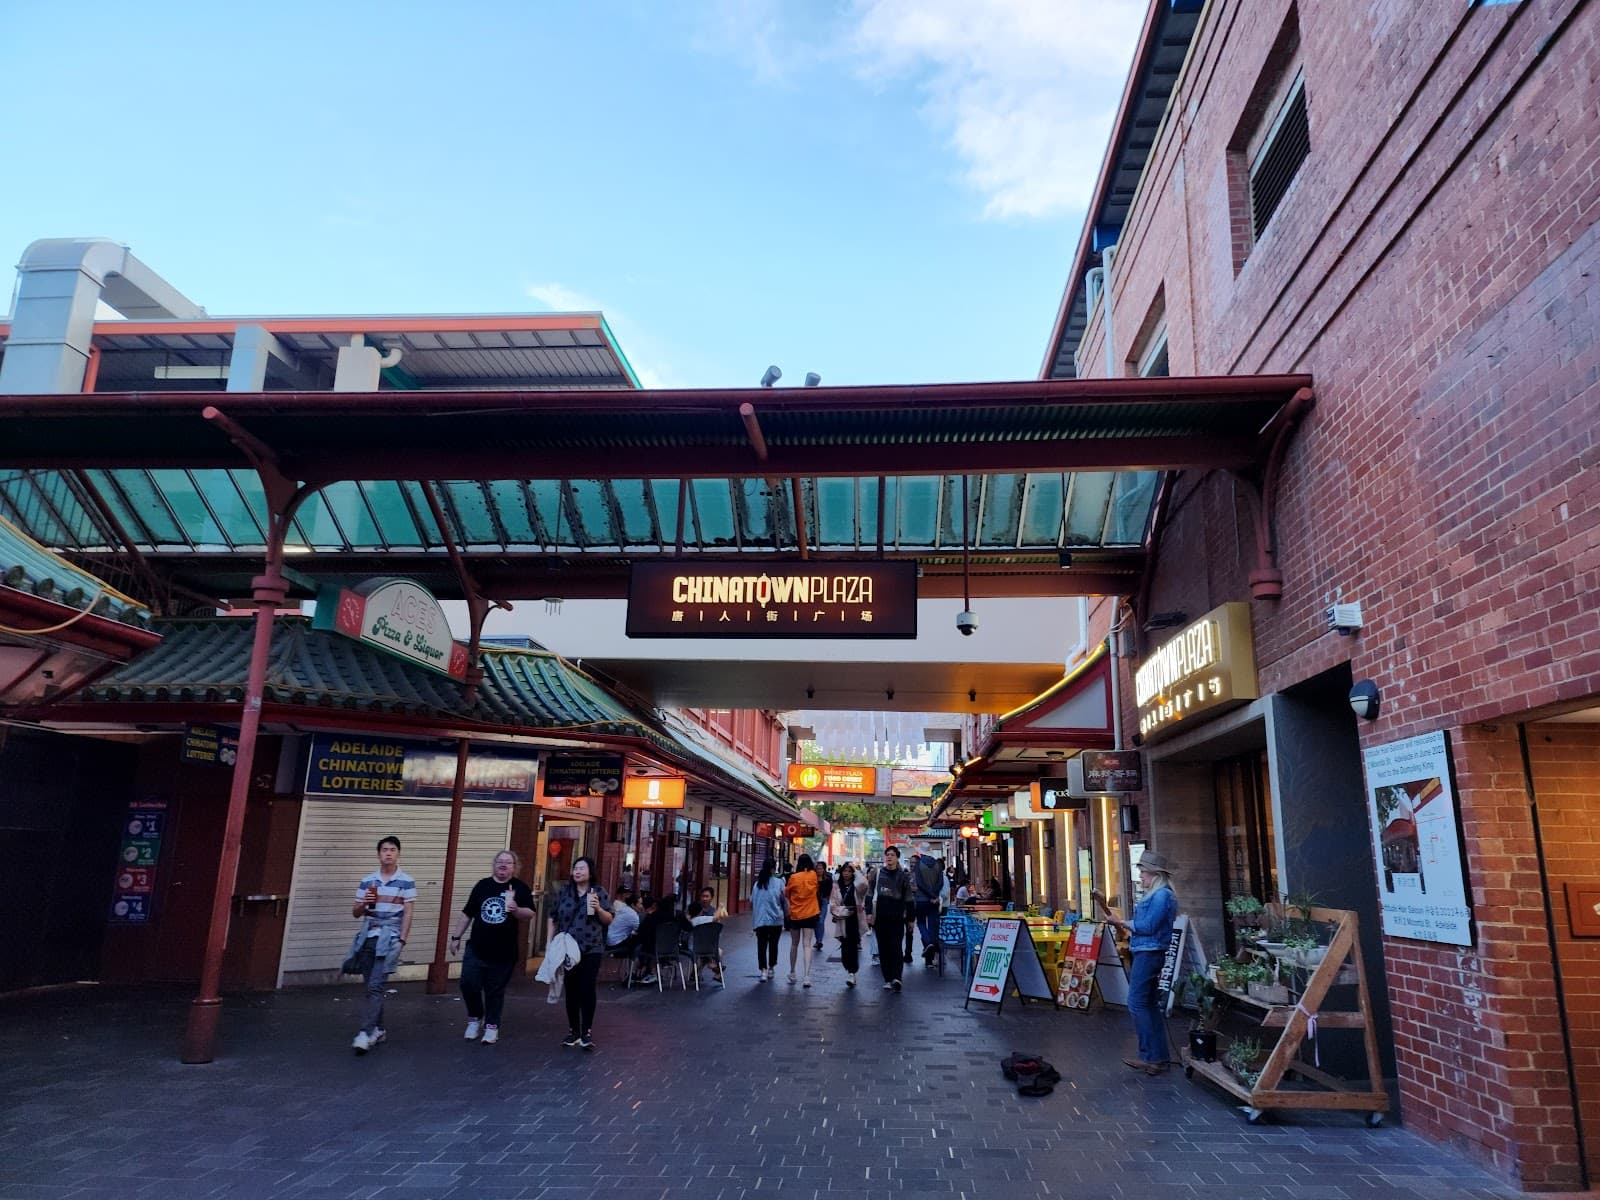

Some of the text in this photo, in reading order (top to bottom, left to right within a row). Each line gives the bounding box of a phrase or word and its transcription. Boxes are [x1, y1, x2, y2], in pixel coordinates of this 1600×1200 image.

[390, 589, 435, 635] ACES
[371, 615, 400, 642] Pizza
[403, 629, 412, 646] &
[413, 634, 444, 661] Liquor
[329, 741, 403, 757] ADELAIDE
[322, 776, 404, 791] LOTTERIES
